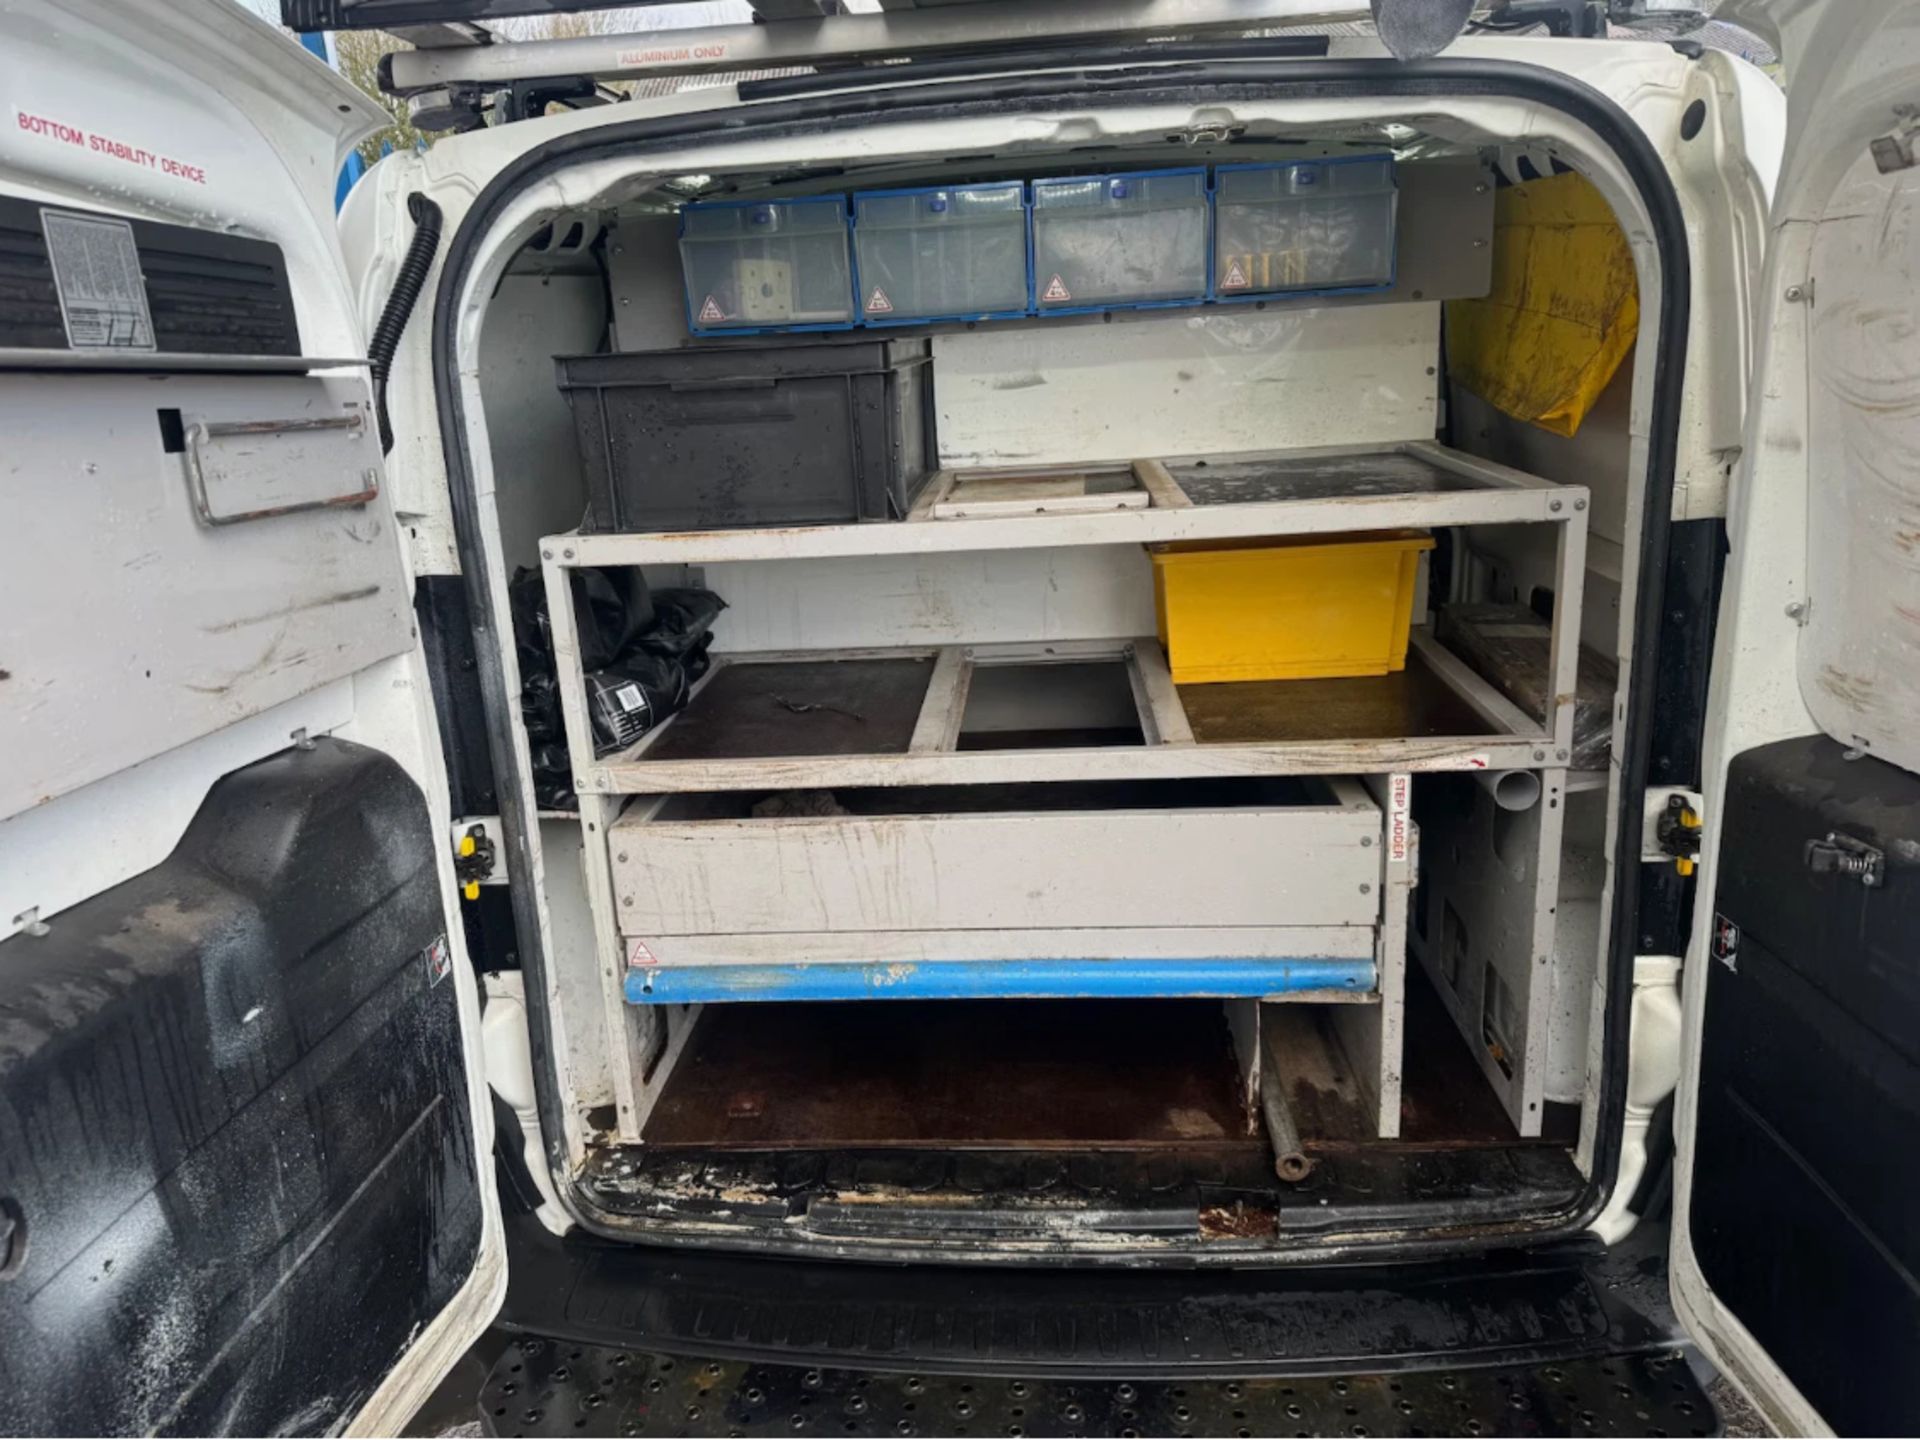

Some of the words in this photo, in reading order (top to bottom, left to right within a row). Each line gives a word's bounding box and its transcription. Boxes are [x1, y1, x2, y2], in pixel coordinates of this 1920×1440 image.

[622, 49, 689, 64] ALUMINIUM
[694, 46, 725, 58] ONLY
[18, 112, 84, 146] BOTTOM
[90, 135, 156, 168] STABILITY
[162, 158, 206, 184] DEVICE
[1394, 778, 1405, 808] STEP
[1393, 811, 1404, 859] LADDER
